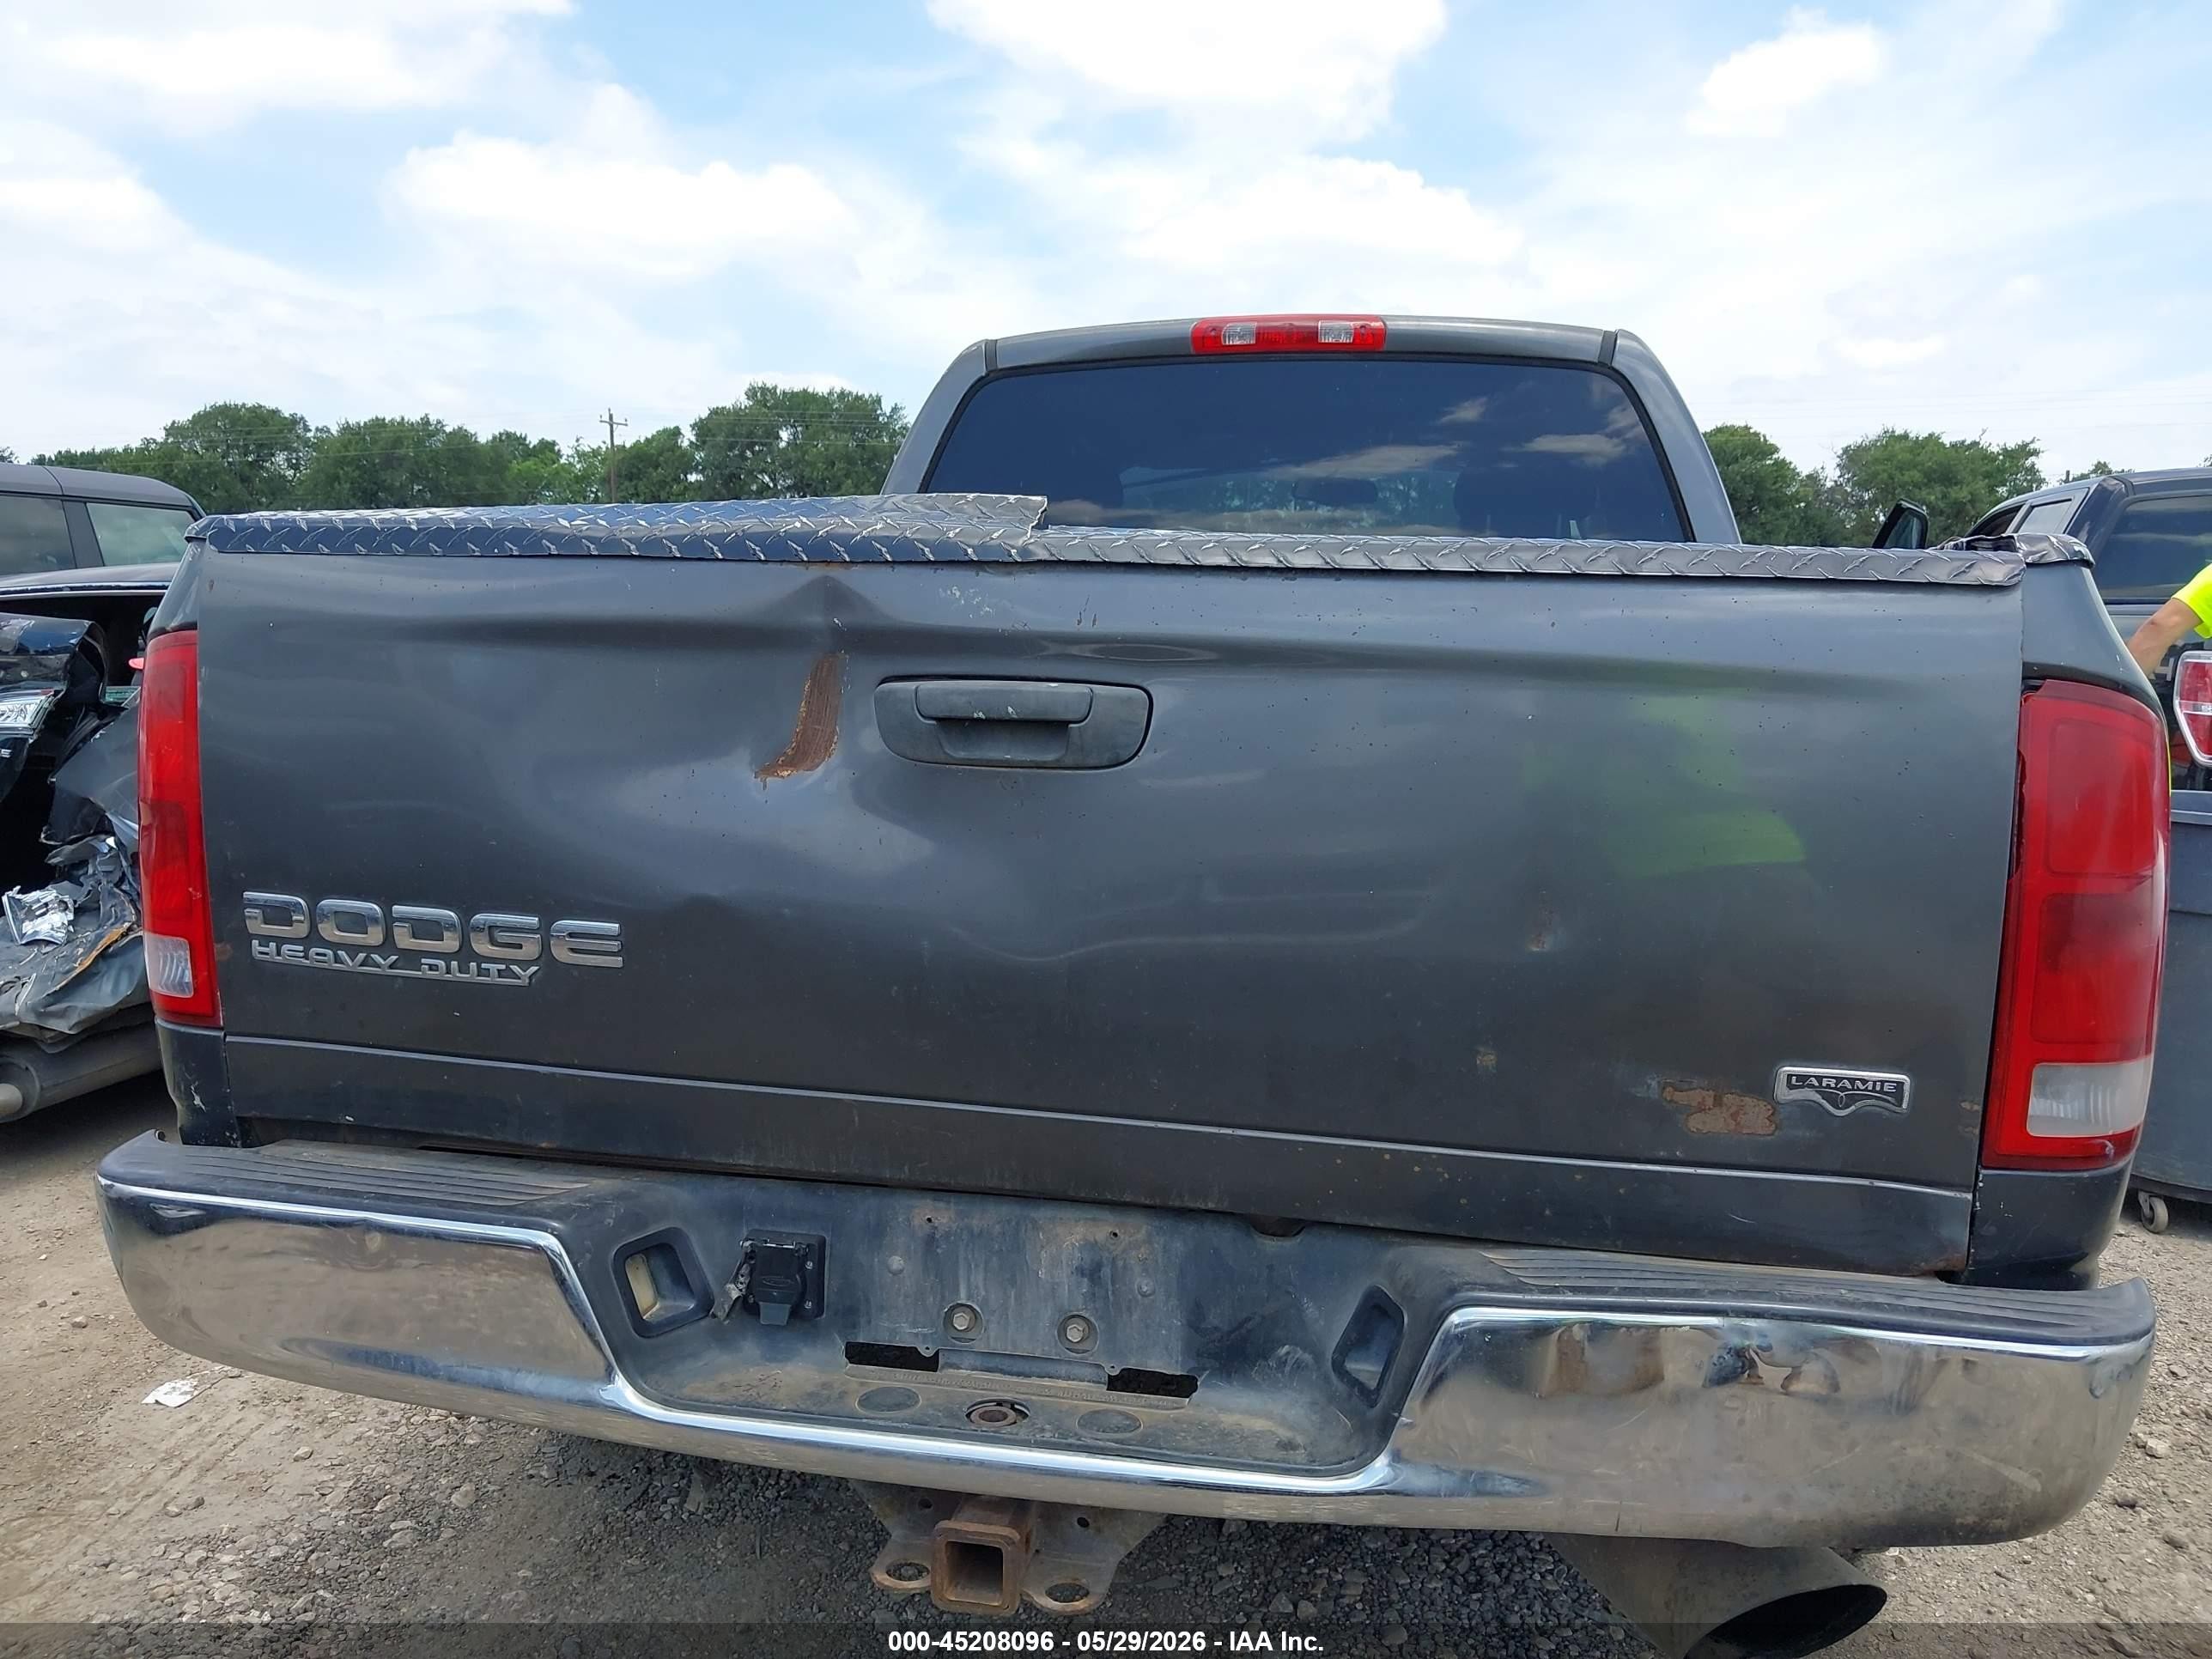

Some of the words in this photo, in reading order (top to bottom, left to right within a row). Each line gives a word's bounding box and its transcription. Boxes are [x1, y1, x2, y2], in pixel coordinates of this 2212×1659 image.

[243, 891, 623, 968] DODGE
[251, 939, 398, 971] HEAVY
[421, 958, 540, 984] DUTY
[1791, 1076, 1897, 1092] LARAMIE
